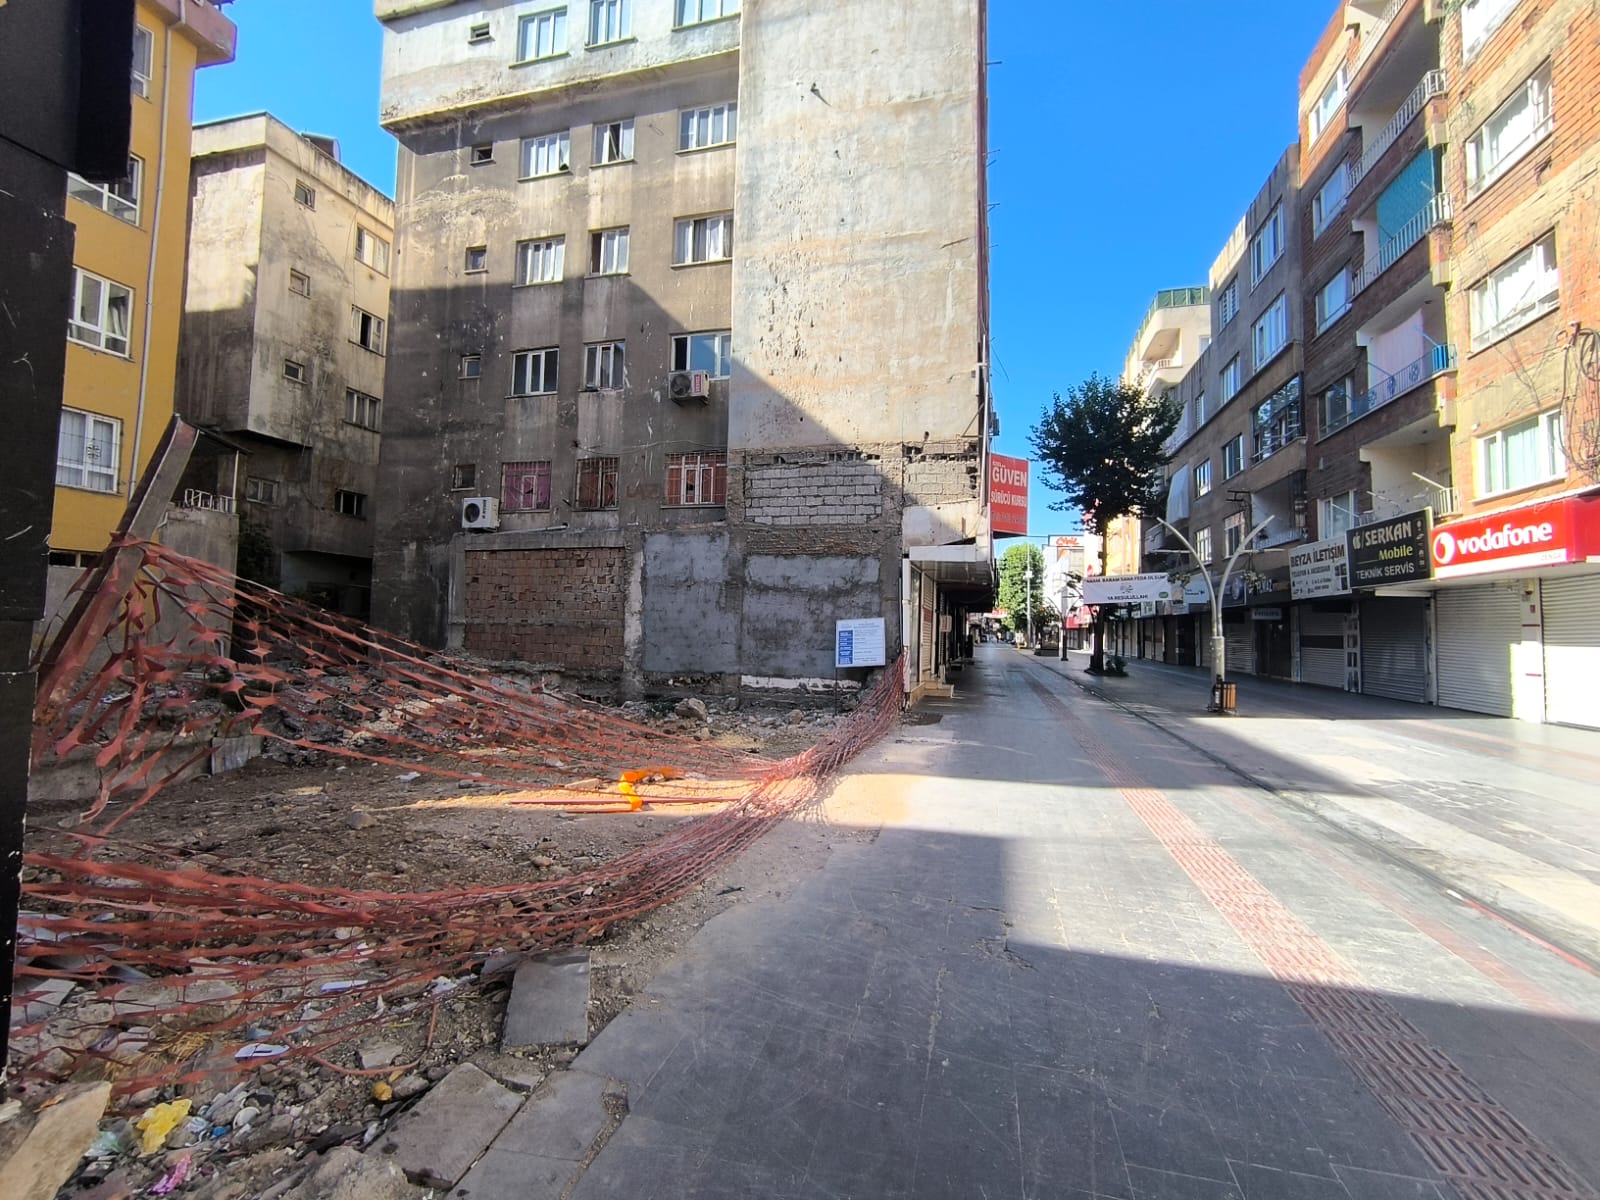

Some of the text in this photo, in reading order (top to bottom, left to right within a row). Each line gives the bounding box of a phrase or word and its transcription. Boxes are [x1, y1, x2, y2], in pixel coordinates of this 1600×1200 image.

[992, 464, 1027, 487] GÜVEN
[991, 489, 1027, 508] SÜRÜCÜ KURSU
[1365, 521, 1412, 547] SERKAN
[1457, 522, 1553, 555] vodafone
[1291, 543, 1345, 568] BEYZA İLETİŞİM
[1379, 545, 1413, 560] Mobile
[1356, 561, 1415, 579] TEKNİK SERVİS
